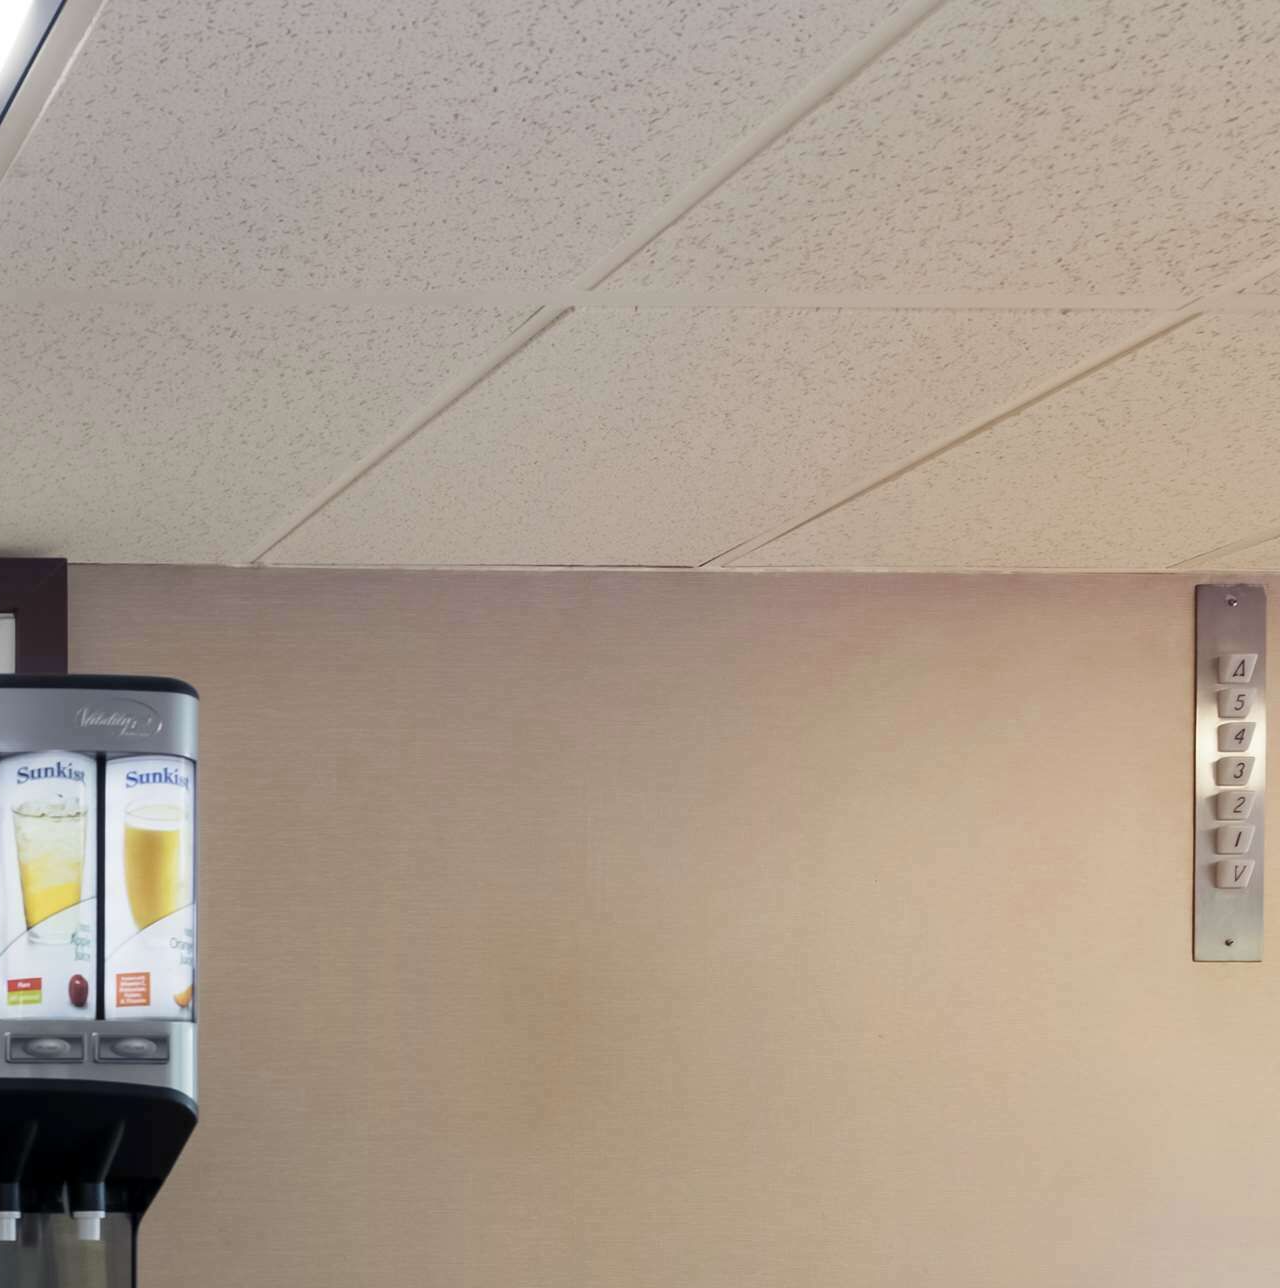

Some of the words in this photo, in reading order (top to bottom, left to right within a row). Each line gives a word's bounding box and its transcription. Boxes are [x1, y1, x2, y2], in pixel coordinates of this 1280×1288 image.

[1234, 694, 1246, 711] 5
[1234, 728, 1246, 744] 4
[16, 761, 86, 785] Sunkist
[125, 767, 190, 791] Sunkist
[1233, 762, 1246, 779] 3
[1233, 796, 1246, 813] 2
